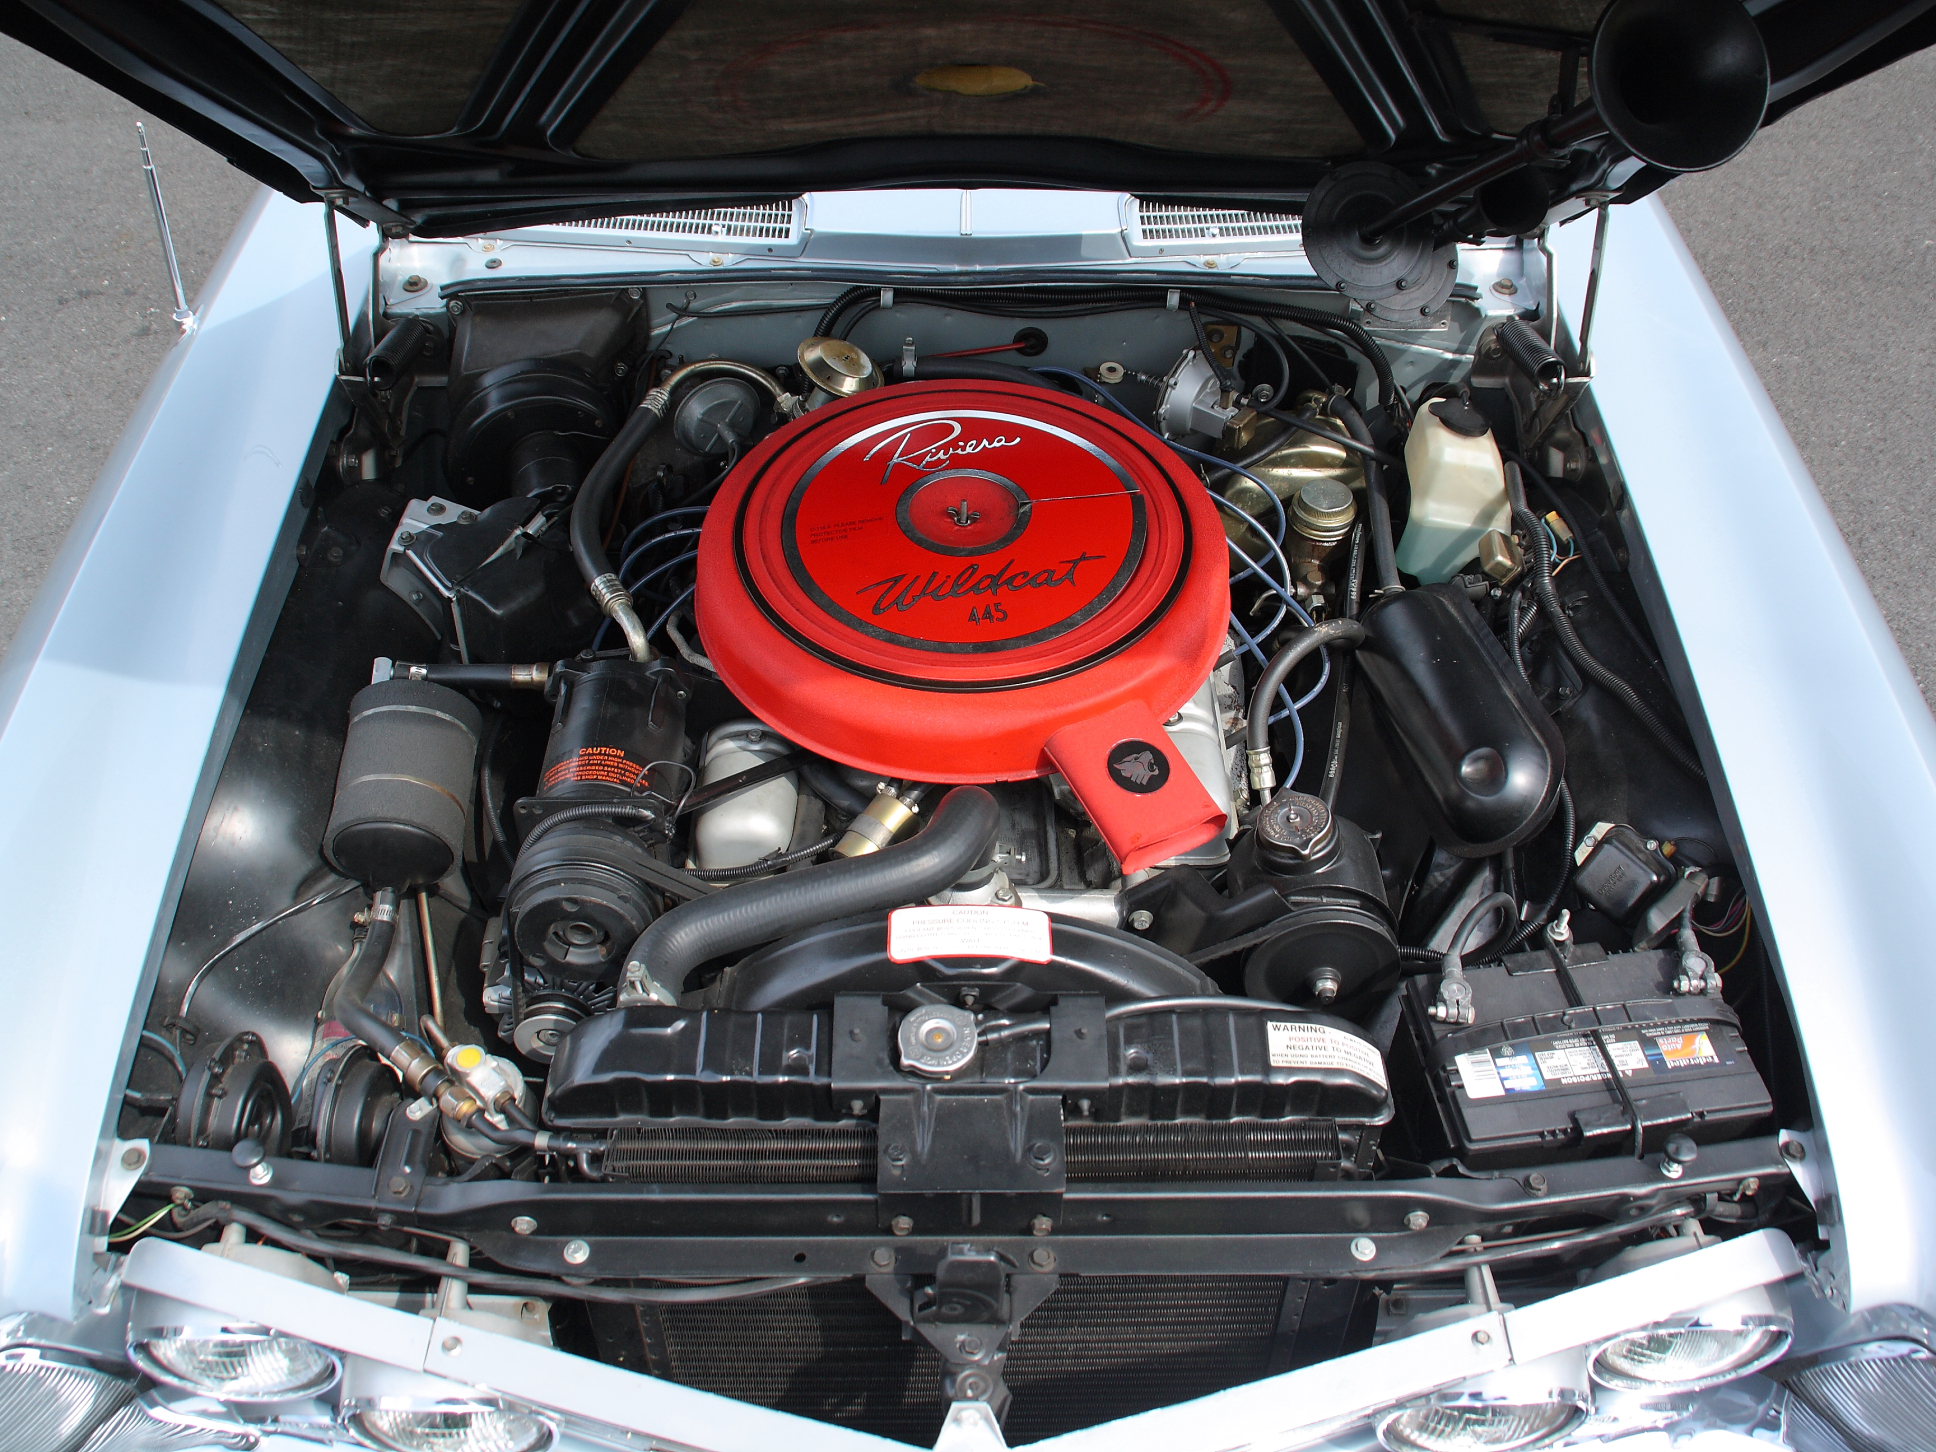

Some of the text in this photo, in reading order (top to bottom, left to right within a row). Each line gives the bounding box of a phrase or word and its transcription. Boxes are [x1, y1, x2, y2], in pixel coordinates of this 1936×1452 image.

[863, 419, 1021, 485] Riviera
[856, 552, 1107, 616] Wildcat
[968, 603, 1009, 626] 445
[579, 746, 625, 757] CAUTION
[1271, 1023, 1326, 1034] WARNING
[1288, 1036, 1327, 1044] POSITIVE
[1658, 1036, 1683, 1045] Parts
[1662, 1043, 1682, 1051] Auto
[1667, 1055, 1720, 1070] Federated
